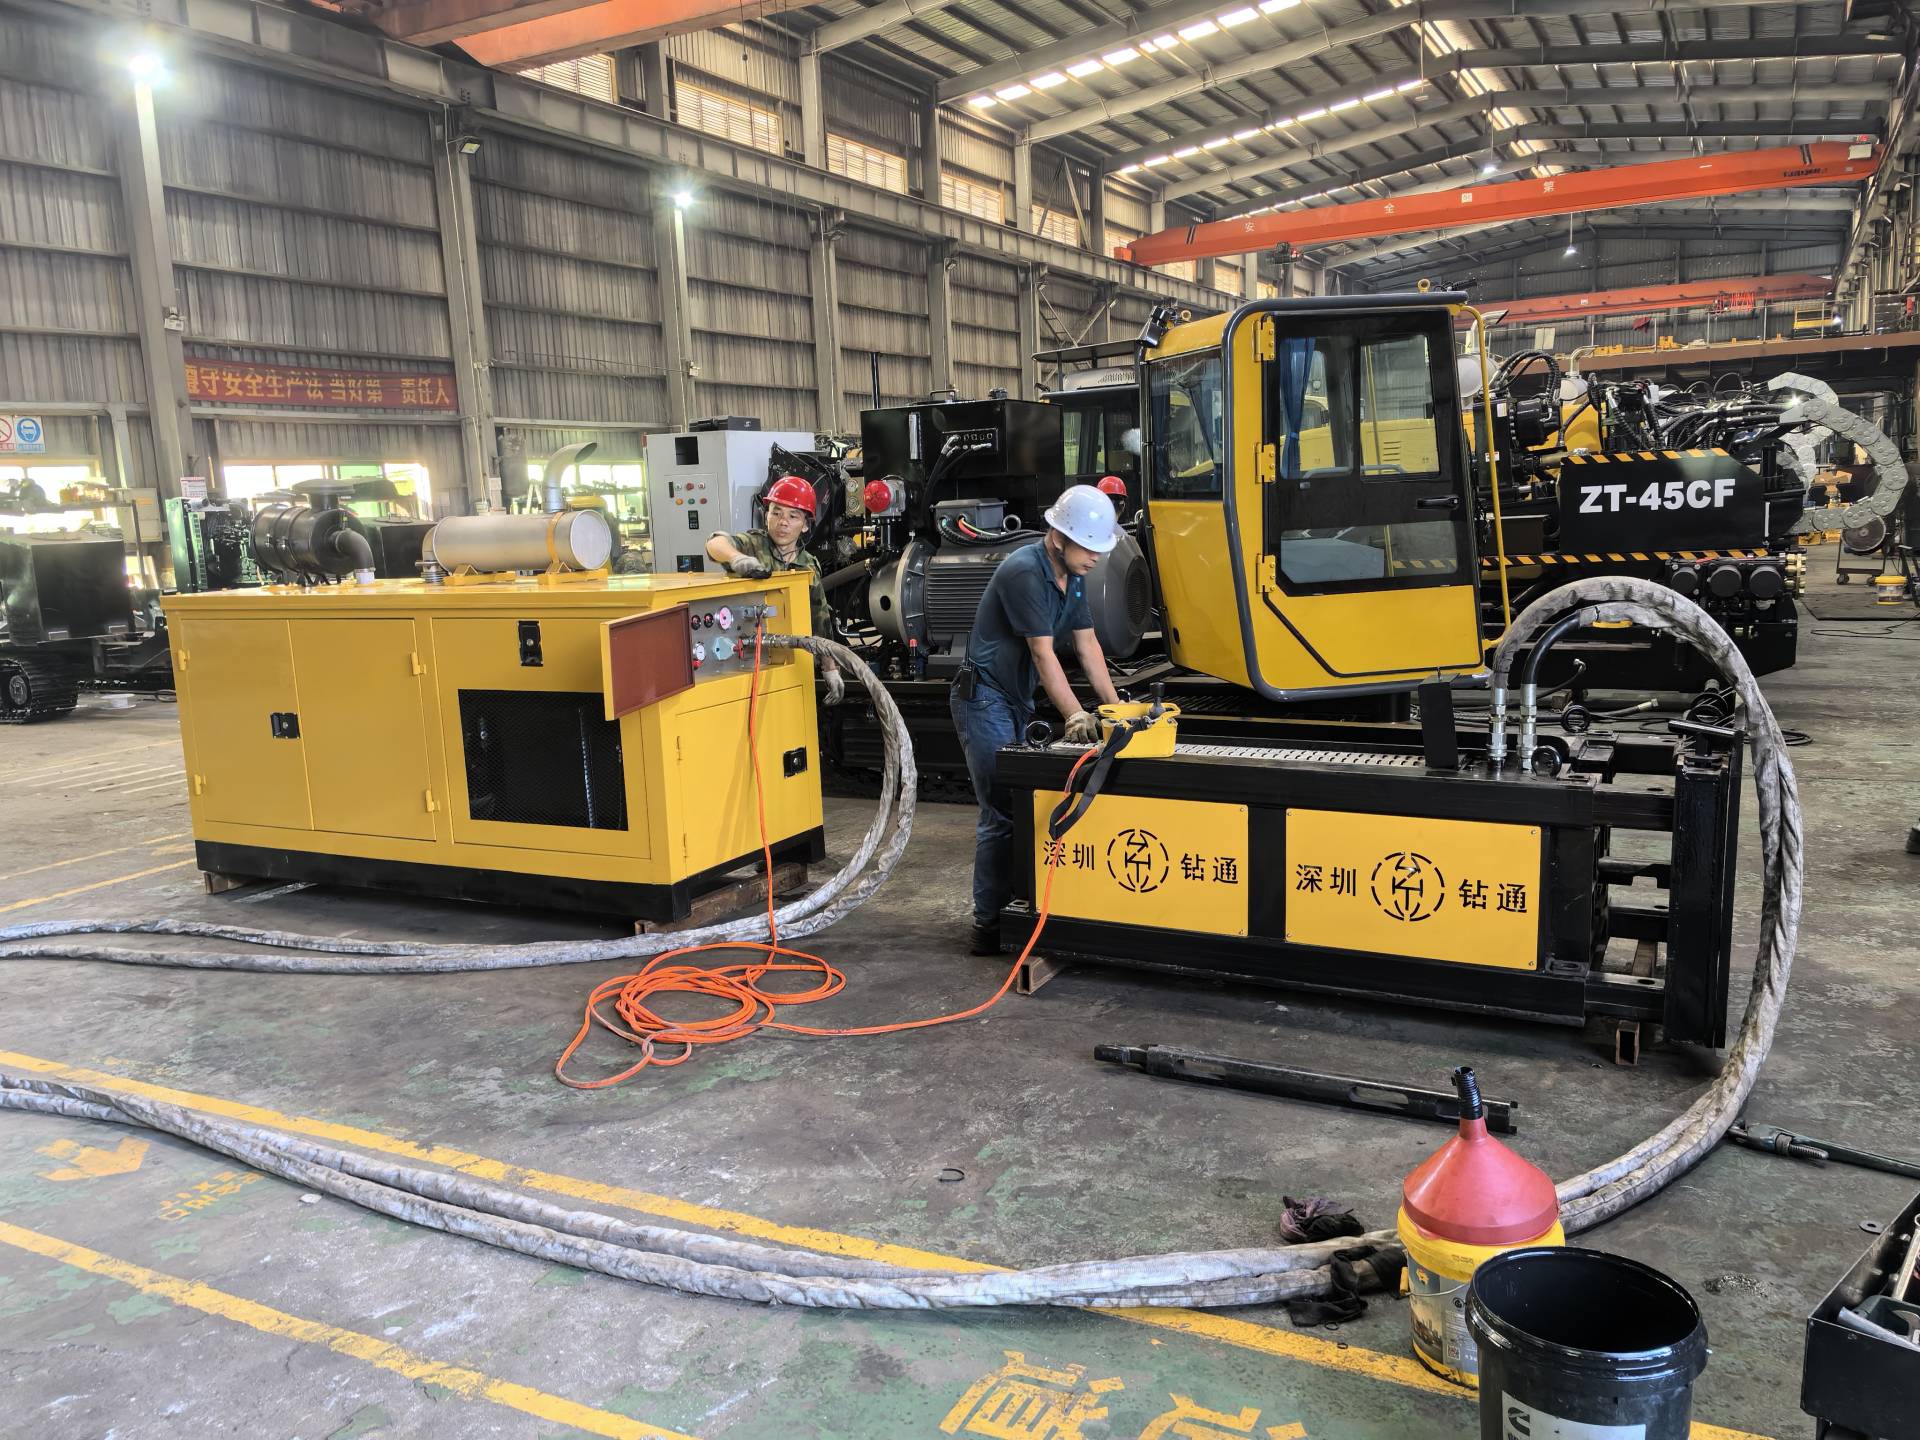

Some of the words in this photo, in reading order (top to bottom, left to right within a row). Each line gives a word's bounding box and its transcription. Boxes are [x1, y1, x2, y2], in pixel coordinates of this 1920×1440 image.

[1579, 478, 1736, 514] ZT-45CF
[1043, 840, 1096, 871] 深圳
[1181, 853, 1239, 885] 钻通
[1296, 864, 1357, 897] 深圳
[1458, 878, 1528, 914] 钻通
